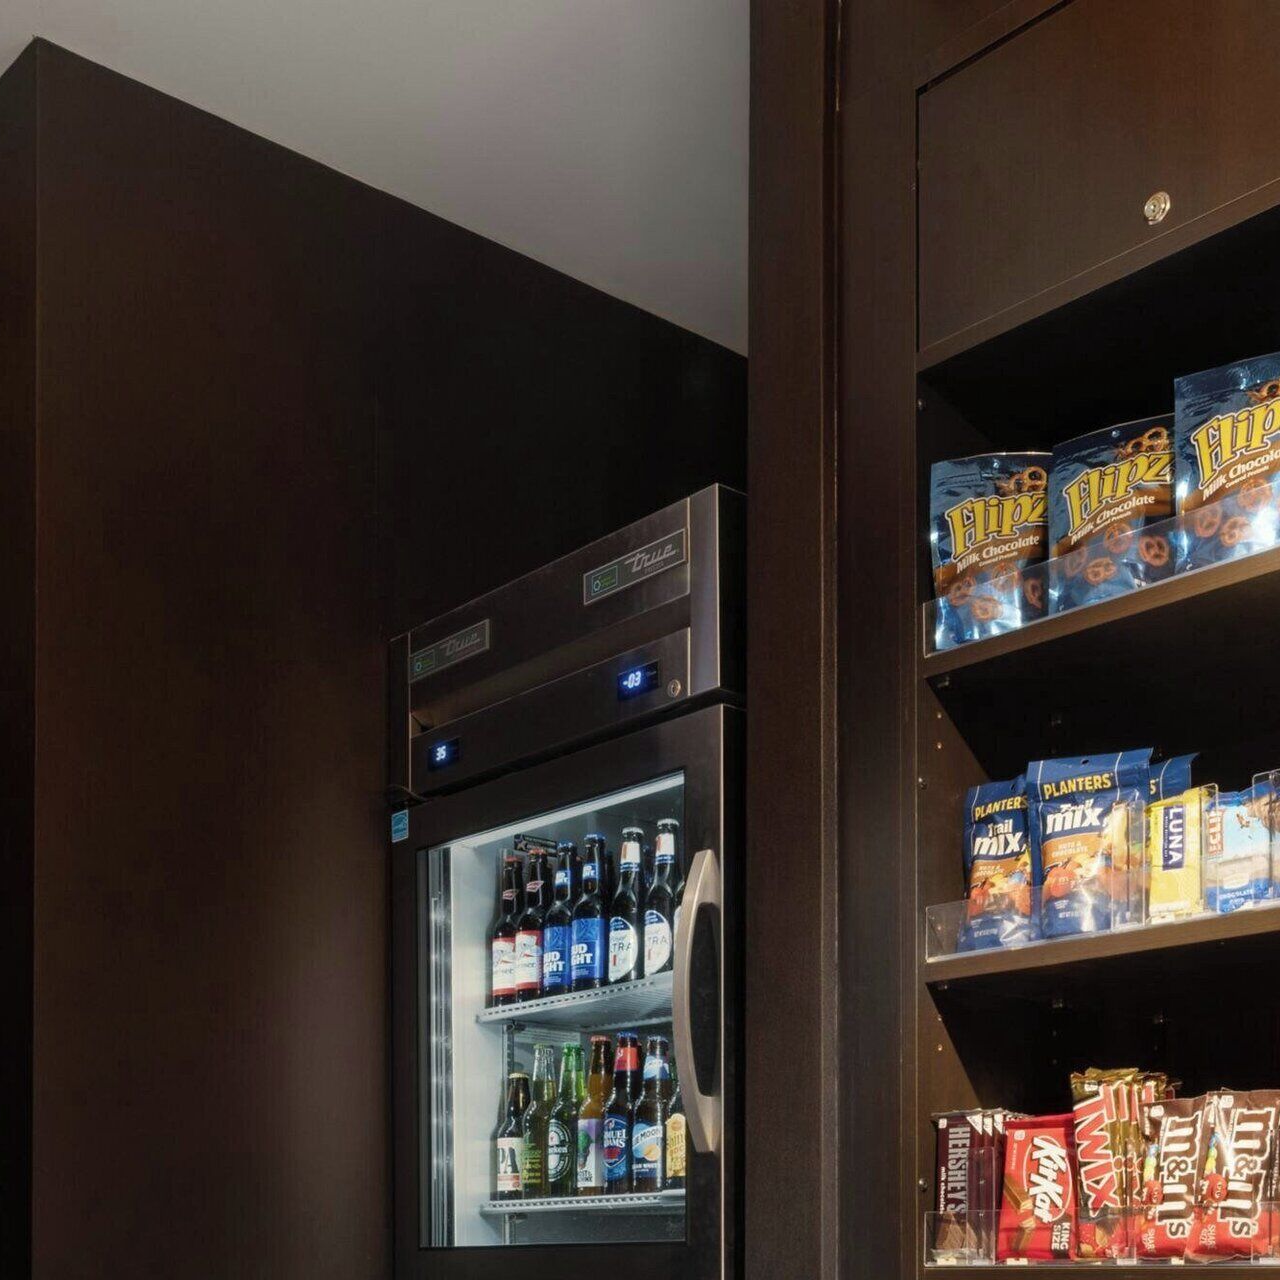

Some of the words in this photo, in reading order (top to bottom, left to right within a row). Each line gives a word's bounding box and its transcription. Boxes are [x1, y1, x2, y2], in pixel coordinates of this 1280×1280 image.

[1063, 450, 1176, 537] Flipz
[1202, 477, 1228, 501] Milk
[945, 490, 1049, 562] Flipz
[1070, 523, 1094, 545] Milk
[1095, 494, 1156, 524] Chocolate
[955, 551, 980, 575] Milk
[981, 534, 1040, 560] Chocolate
[1043, 773, 1112, 799] PLANTERS
[988, 819, 1013, 838] Trail
[1169, 808, 1185, 865] LUNA
[947, 1126, 971, 1214] HERSHEY'S
[1074, 1083, 1121, 1216] TWIX
[1051, 1224, 1061, 1250] SIZE
[1060, 1222, 1070, 1250] KING
